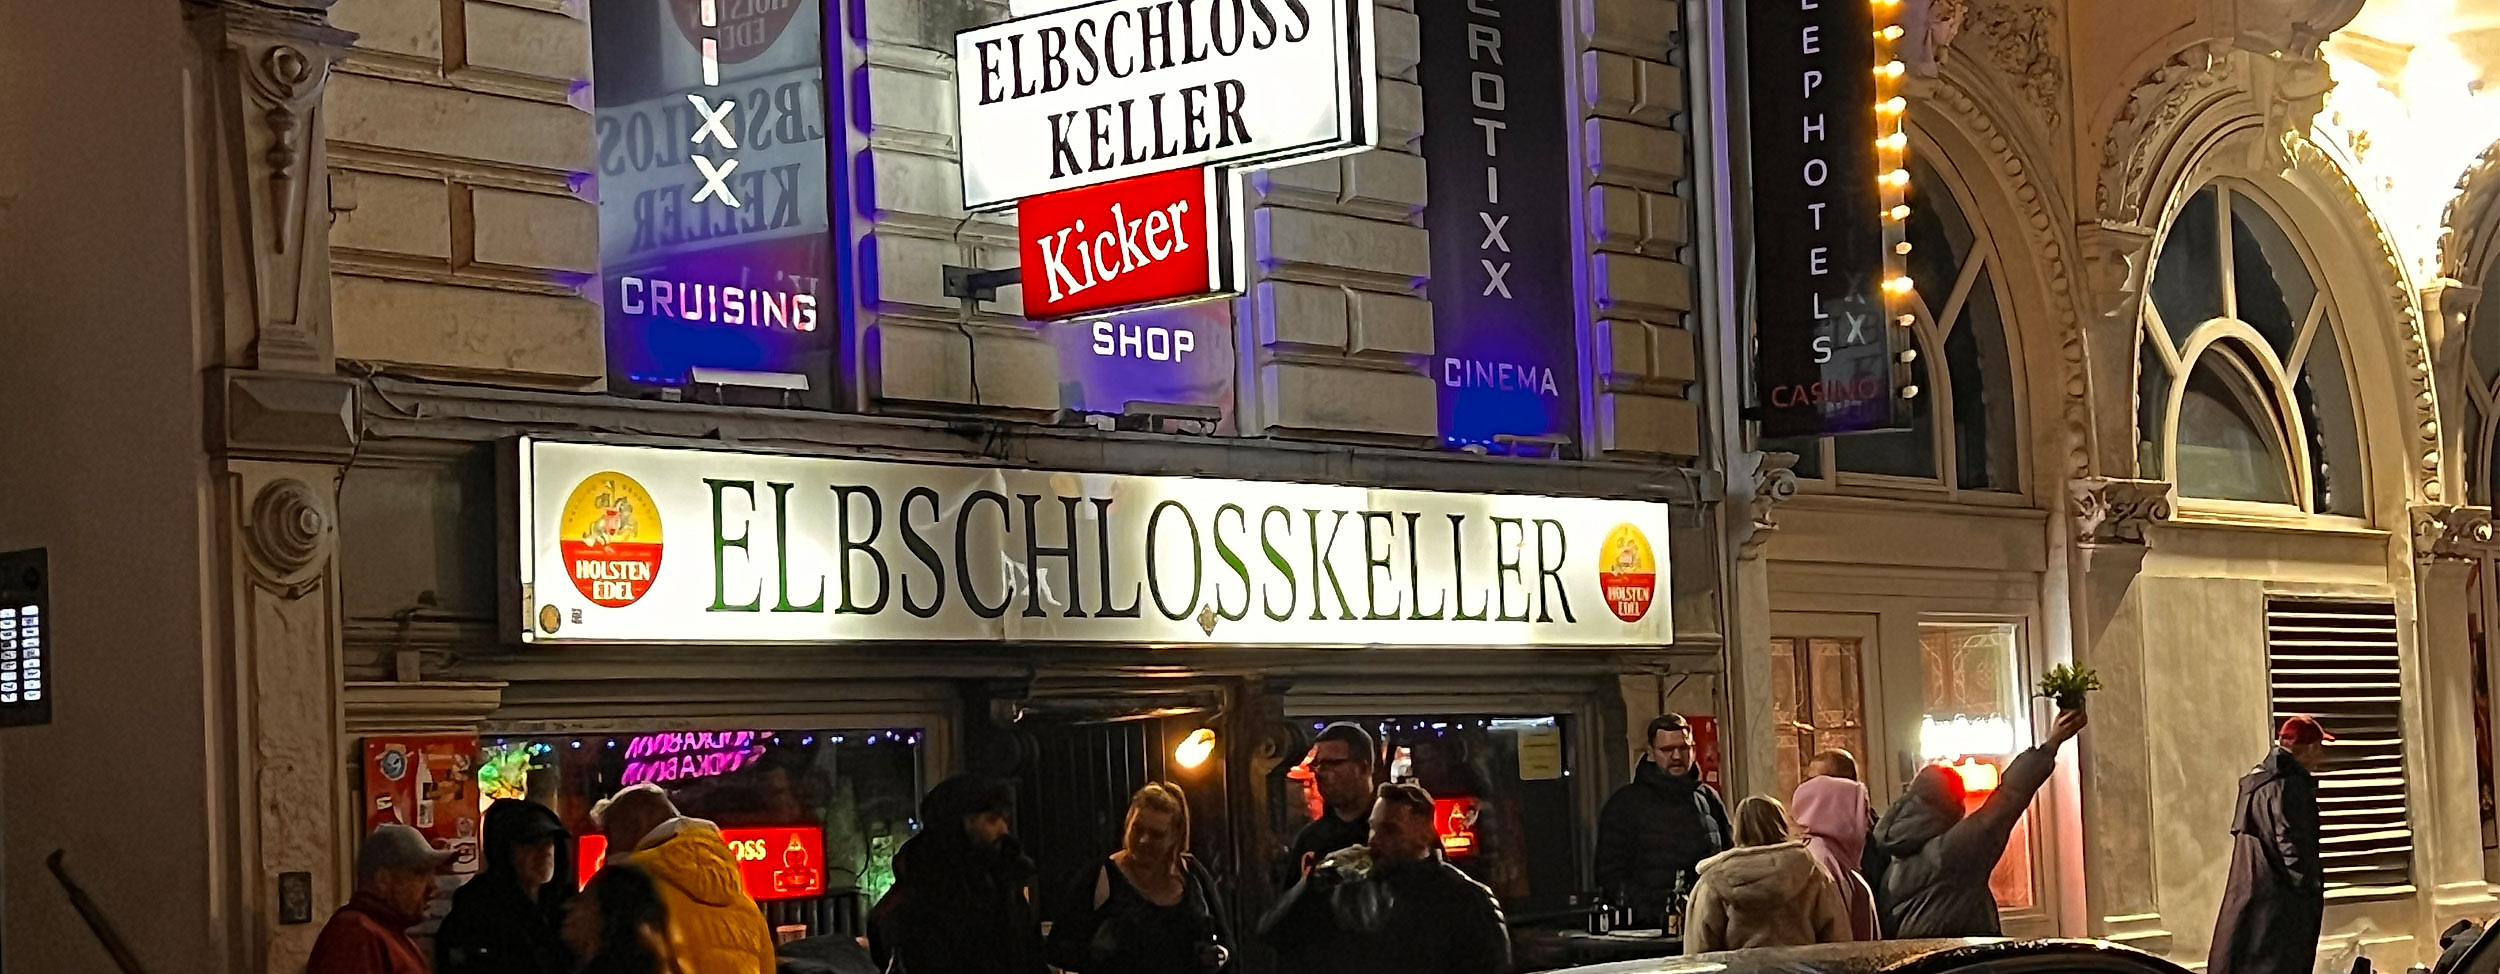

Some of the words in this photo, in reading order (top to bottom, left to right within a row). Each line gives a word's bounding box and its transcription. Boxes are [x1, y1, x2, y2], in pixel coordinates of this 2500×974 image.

[978, 0, 1311, 106] ELBSCHLOSS
[1047, 79, 1252, 180] KELLER
[1036, 199, 1191, 304] Kicker
[620, 276, 818, 333] CRUISING
[1092, 321, 1196, 364] SHOP
[1445, 357, 1559, 396] CINEMA
[1771, 375, 1879, 408] CASINO
[575, 560, 651, 581] HOLSTEN
[702, 477, 1577, 623] ELBSCHLOSSKELLER
[592, 580, 635, 600] EDEL
[1606, 586, 1650, 602] HOLSTEN
